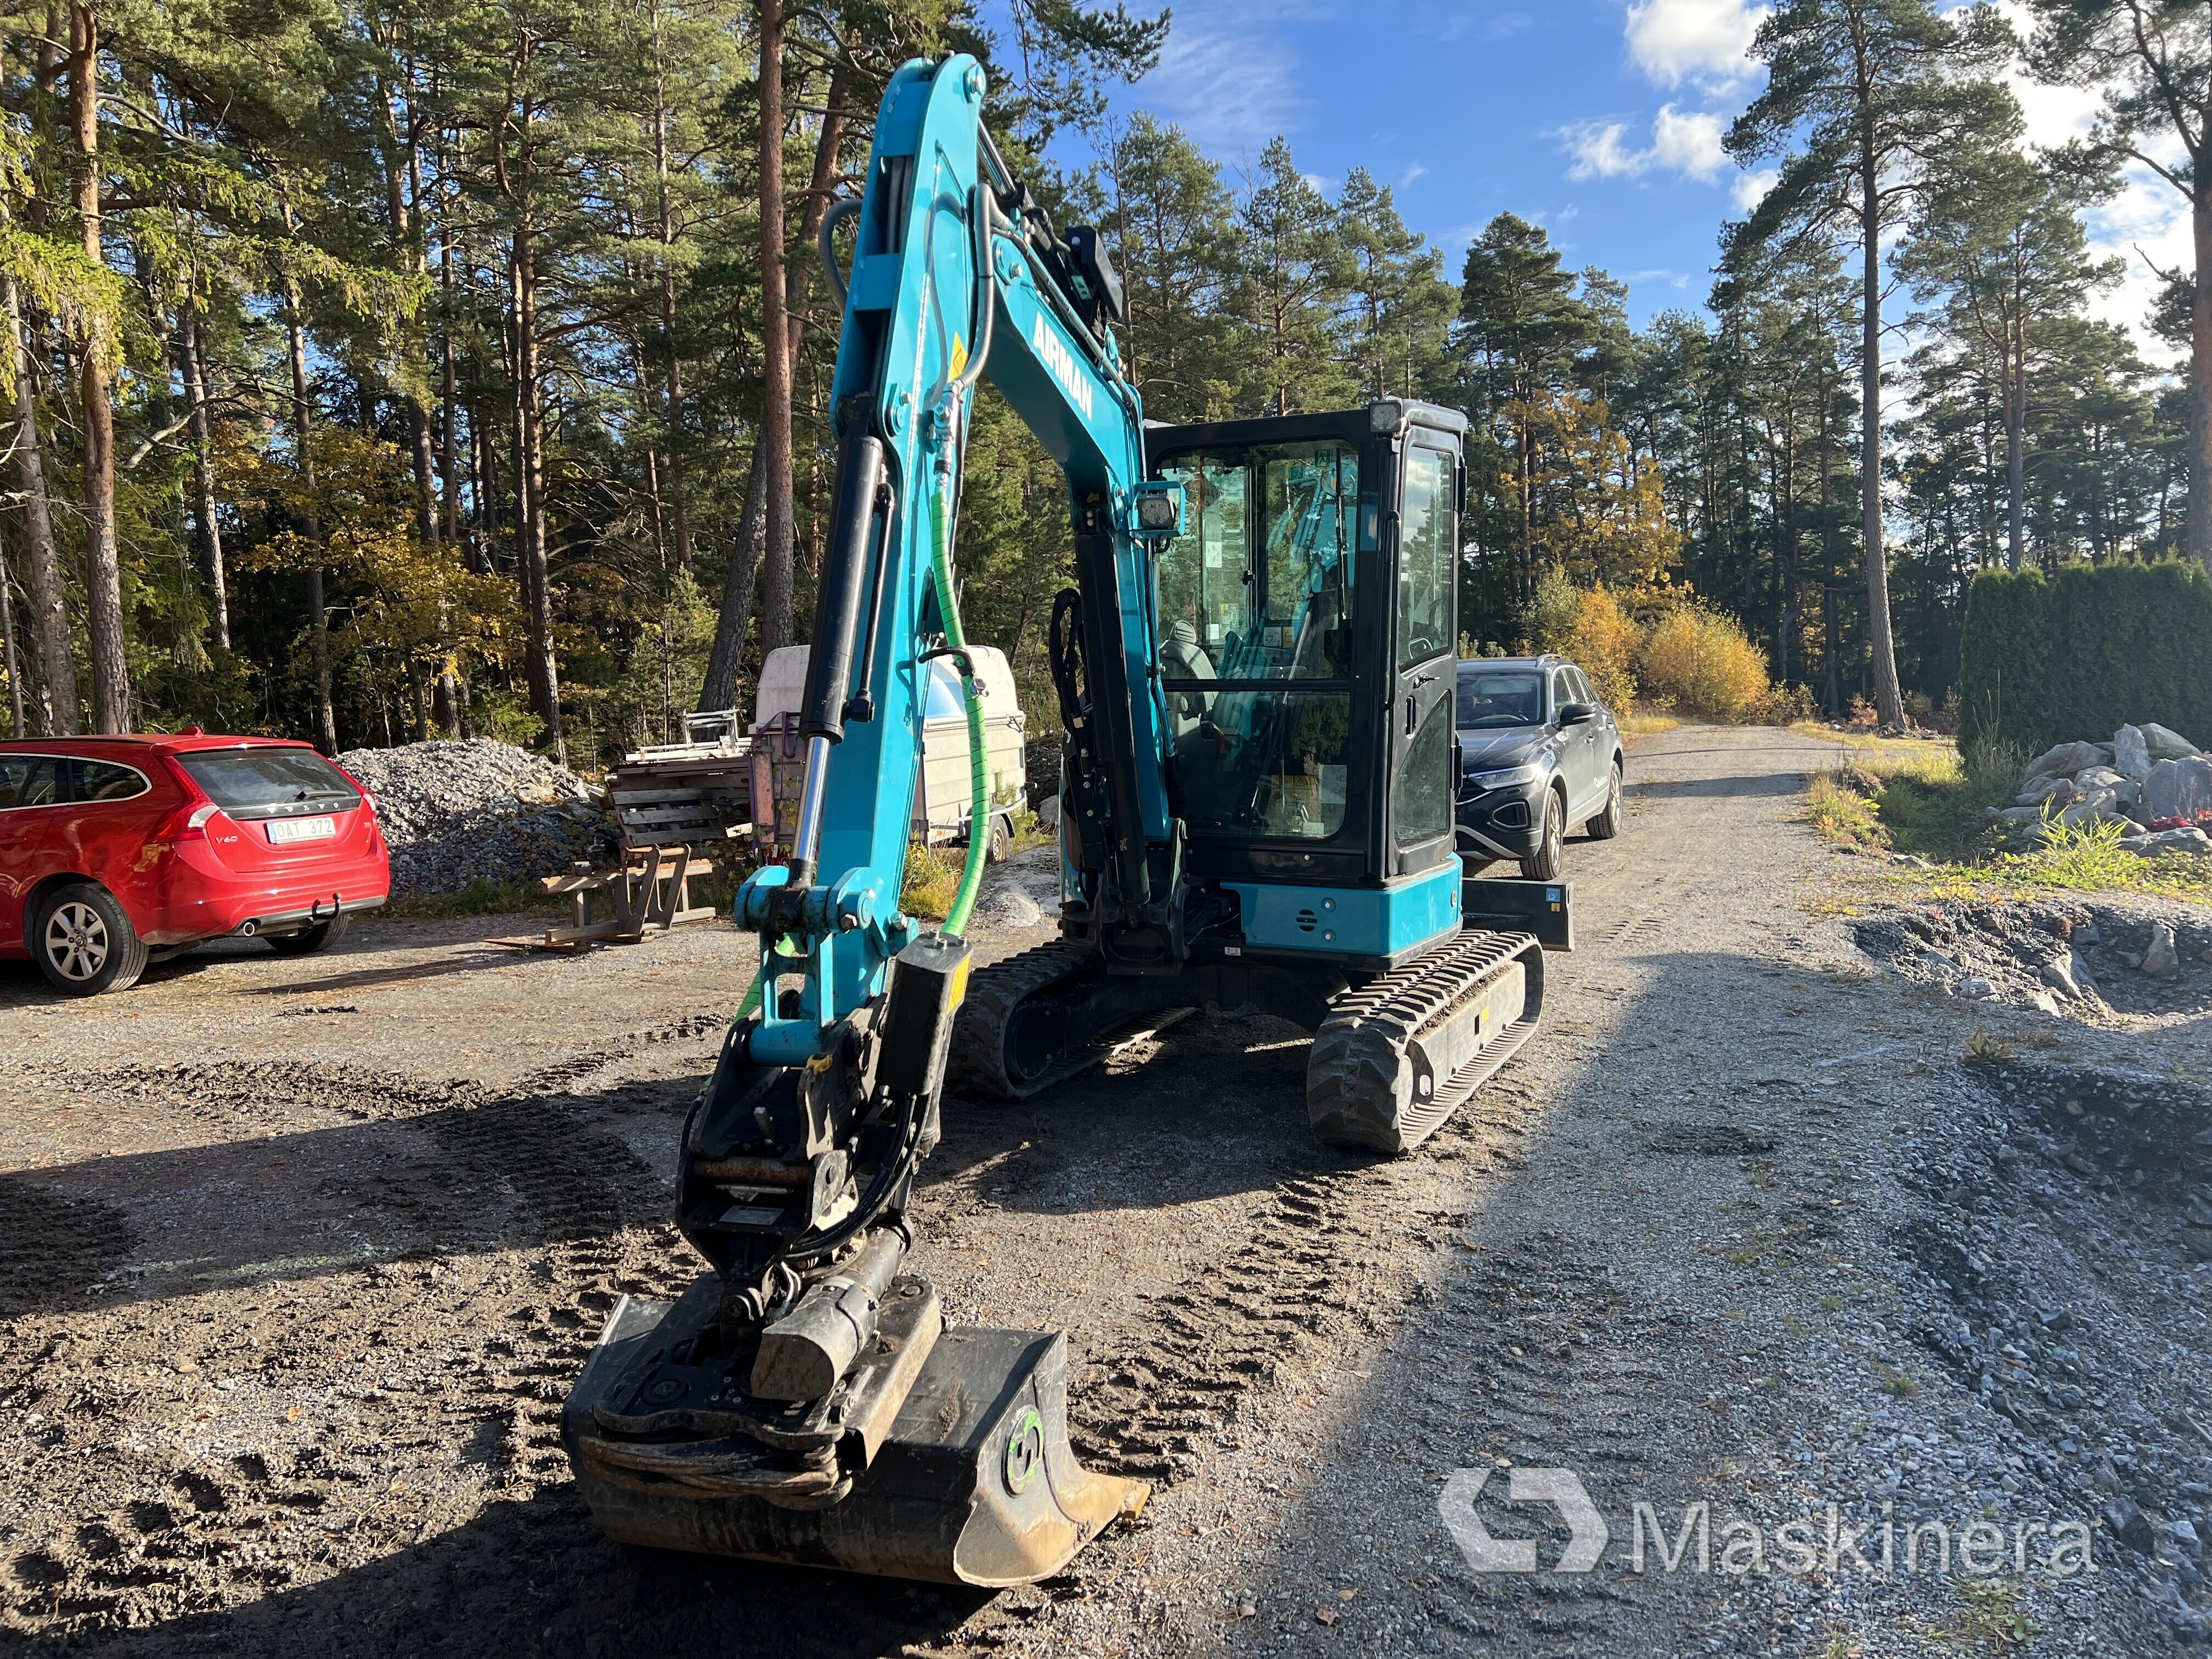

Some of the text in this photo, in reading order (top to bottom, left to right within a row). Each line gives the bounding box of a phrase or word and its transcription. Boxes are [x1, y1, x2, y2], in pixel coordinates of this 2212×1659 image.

[1033, 311, 1092, 421] AIRMAN
[267, 803, 338, 814] VOLVO
[276, 820, 332, 837] OAT 372
